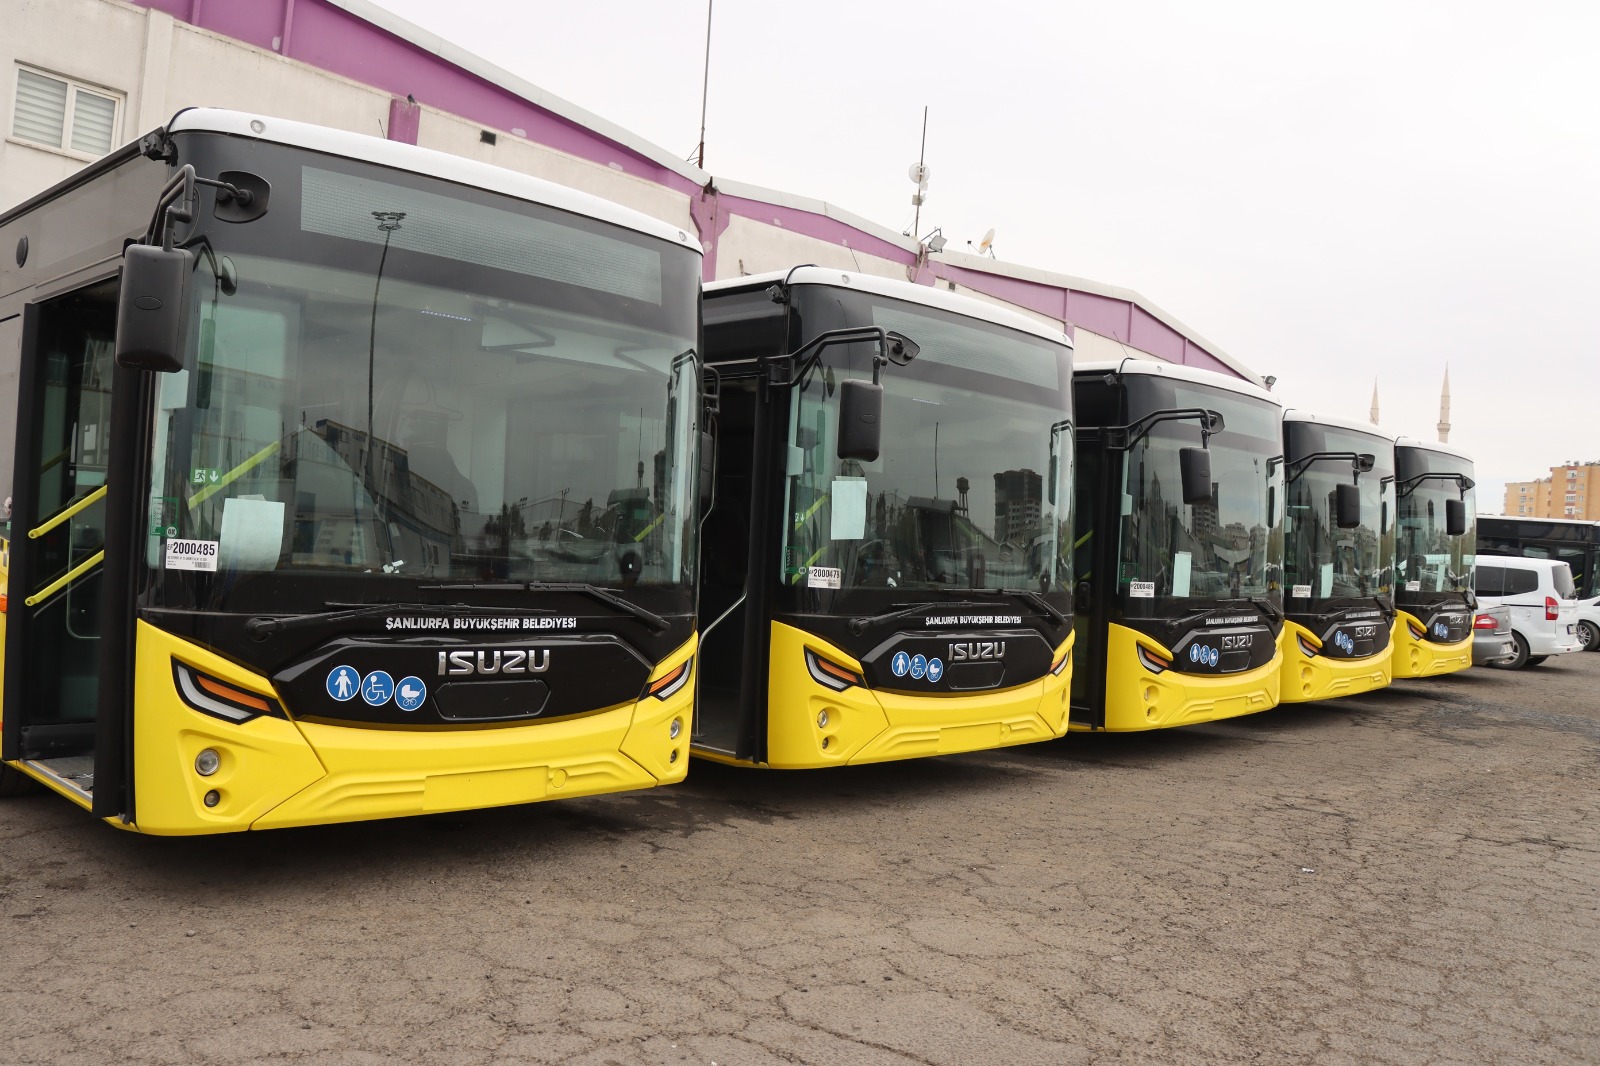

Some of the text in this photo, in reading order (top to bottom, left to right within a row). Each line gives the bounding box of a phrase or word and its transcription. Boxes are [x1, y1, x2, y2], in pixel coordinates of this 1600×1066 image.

[167, 528, 176, 536] OK
[386, 617, 577, 631] ŞANLIURFA BÜYÜKŞEHİR BELEDİYESİ
[1221, 634, 1253, 650] ISUZU
[947, 641, 1006, 661] ISUZU
[437, 649, 550, 676] ISUZU
